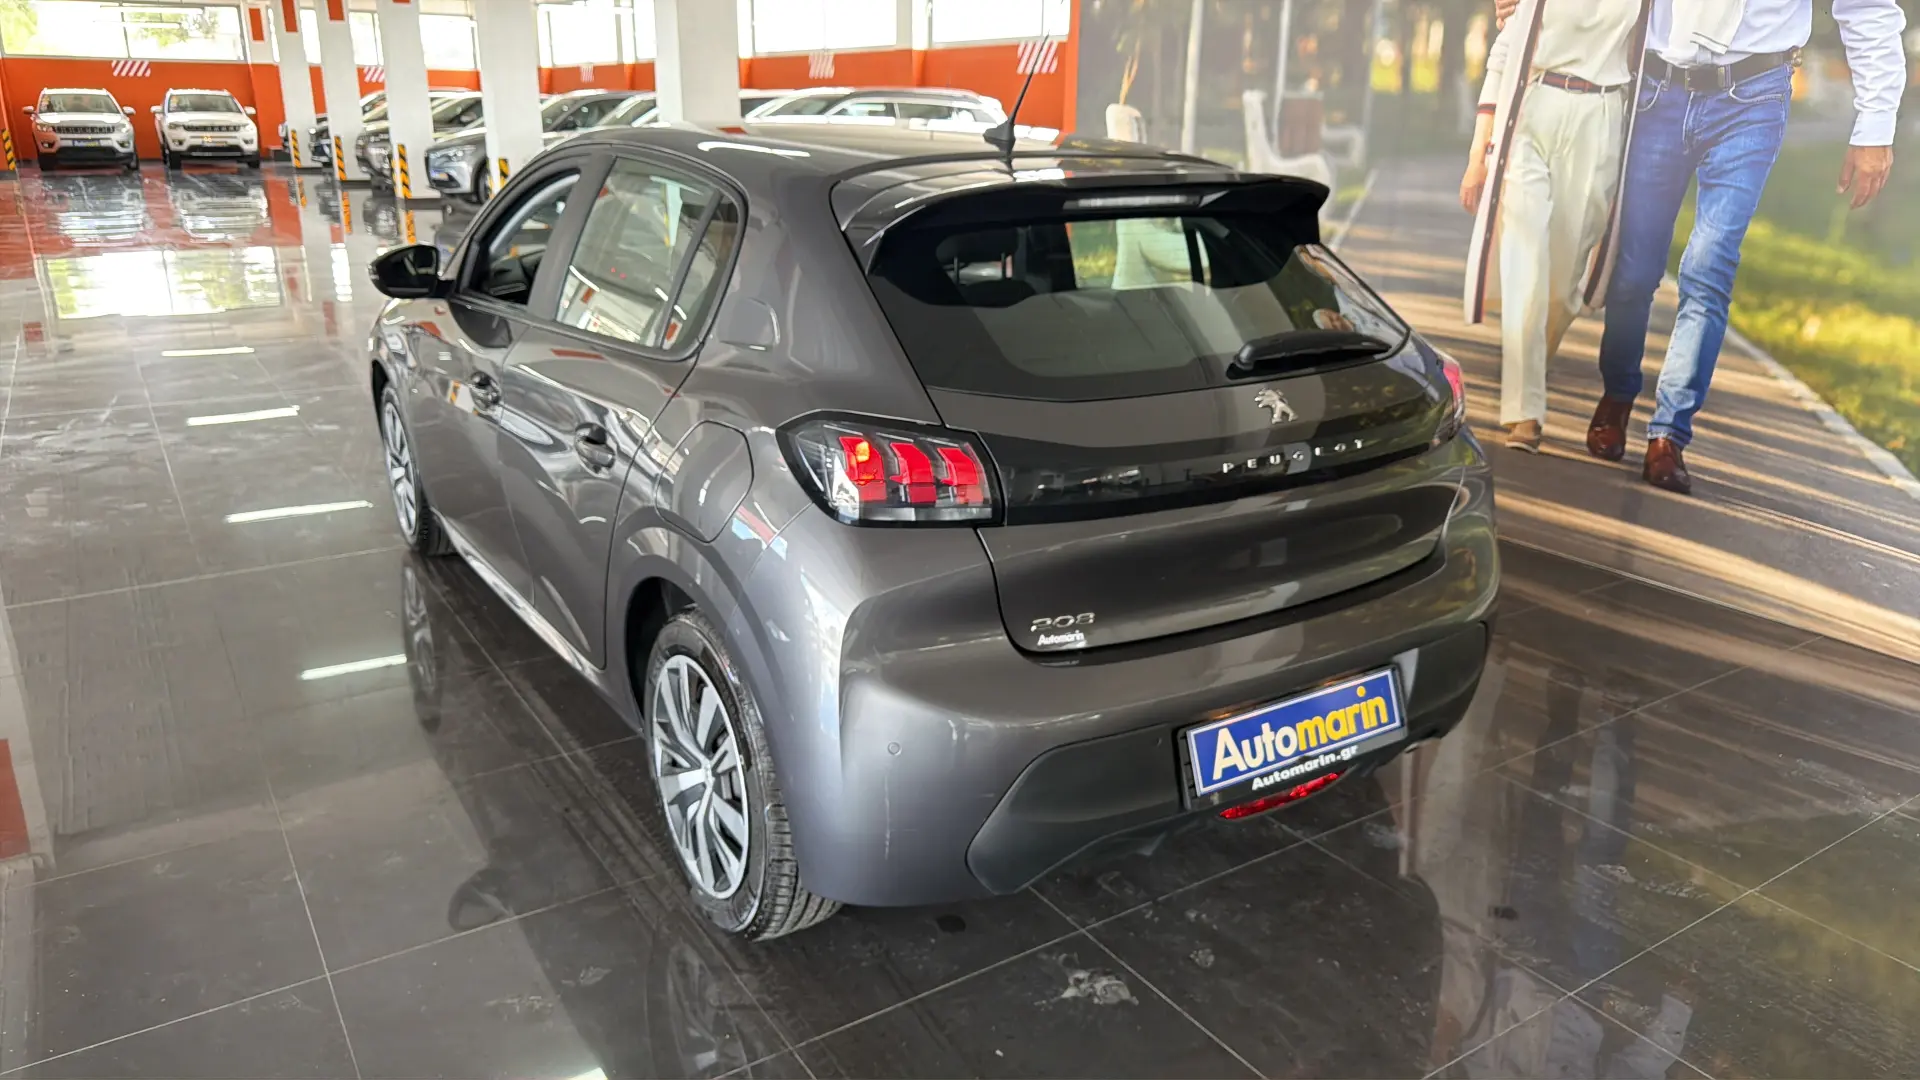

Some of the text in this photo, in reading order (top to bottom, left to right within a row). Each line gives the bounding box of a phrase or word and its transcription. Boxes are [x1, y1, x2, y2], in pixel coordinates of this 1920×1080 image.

[1222, 438, 1364, 474] PEUGEOT
[1030, 612, 1096, 632] 208
[1212, 685, 1389, 781] Automarin
[1251, 744, 1359, 791] Automarin.gr
